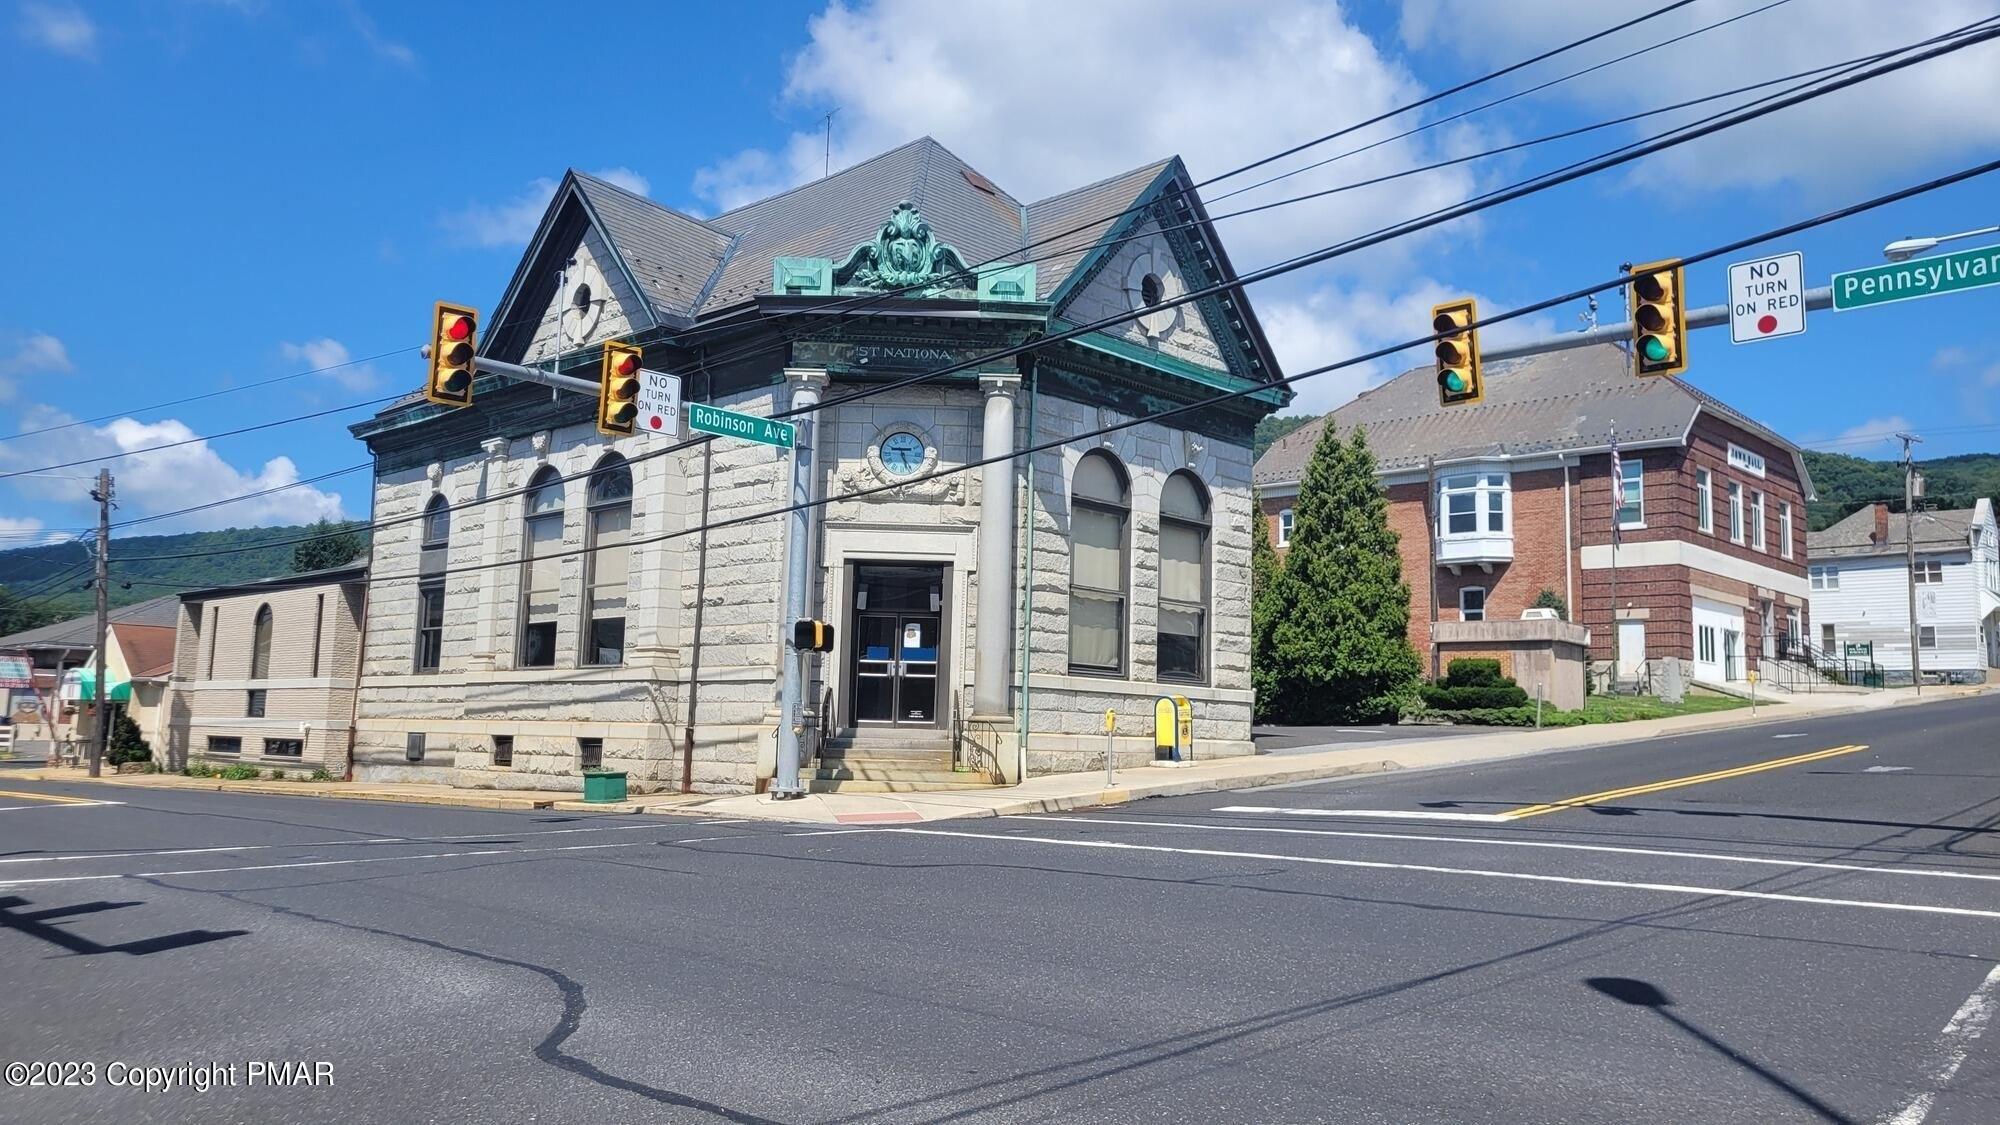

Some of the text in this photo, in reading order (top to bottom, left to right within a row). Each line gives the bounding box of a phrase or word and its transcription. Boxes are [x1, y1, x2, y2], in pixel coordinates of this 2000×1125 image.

[1750, 262, 1779, 280] NO
[1745, 279, 1787, 298] TURN
[1736, 294, 1799, 316] ON RED
[856, 346, 955, 360] ST NATIONA
[650, 375, 667, 389] NO
[646, 389, 671, 403] TURN
[638, 400, 676, 417] ON RED
[696, 408, 788, 441] Robinson Ave
